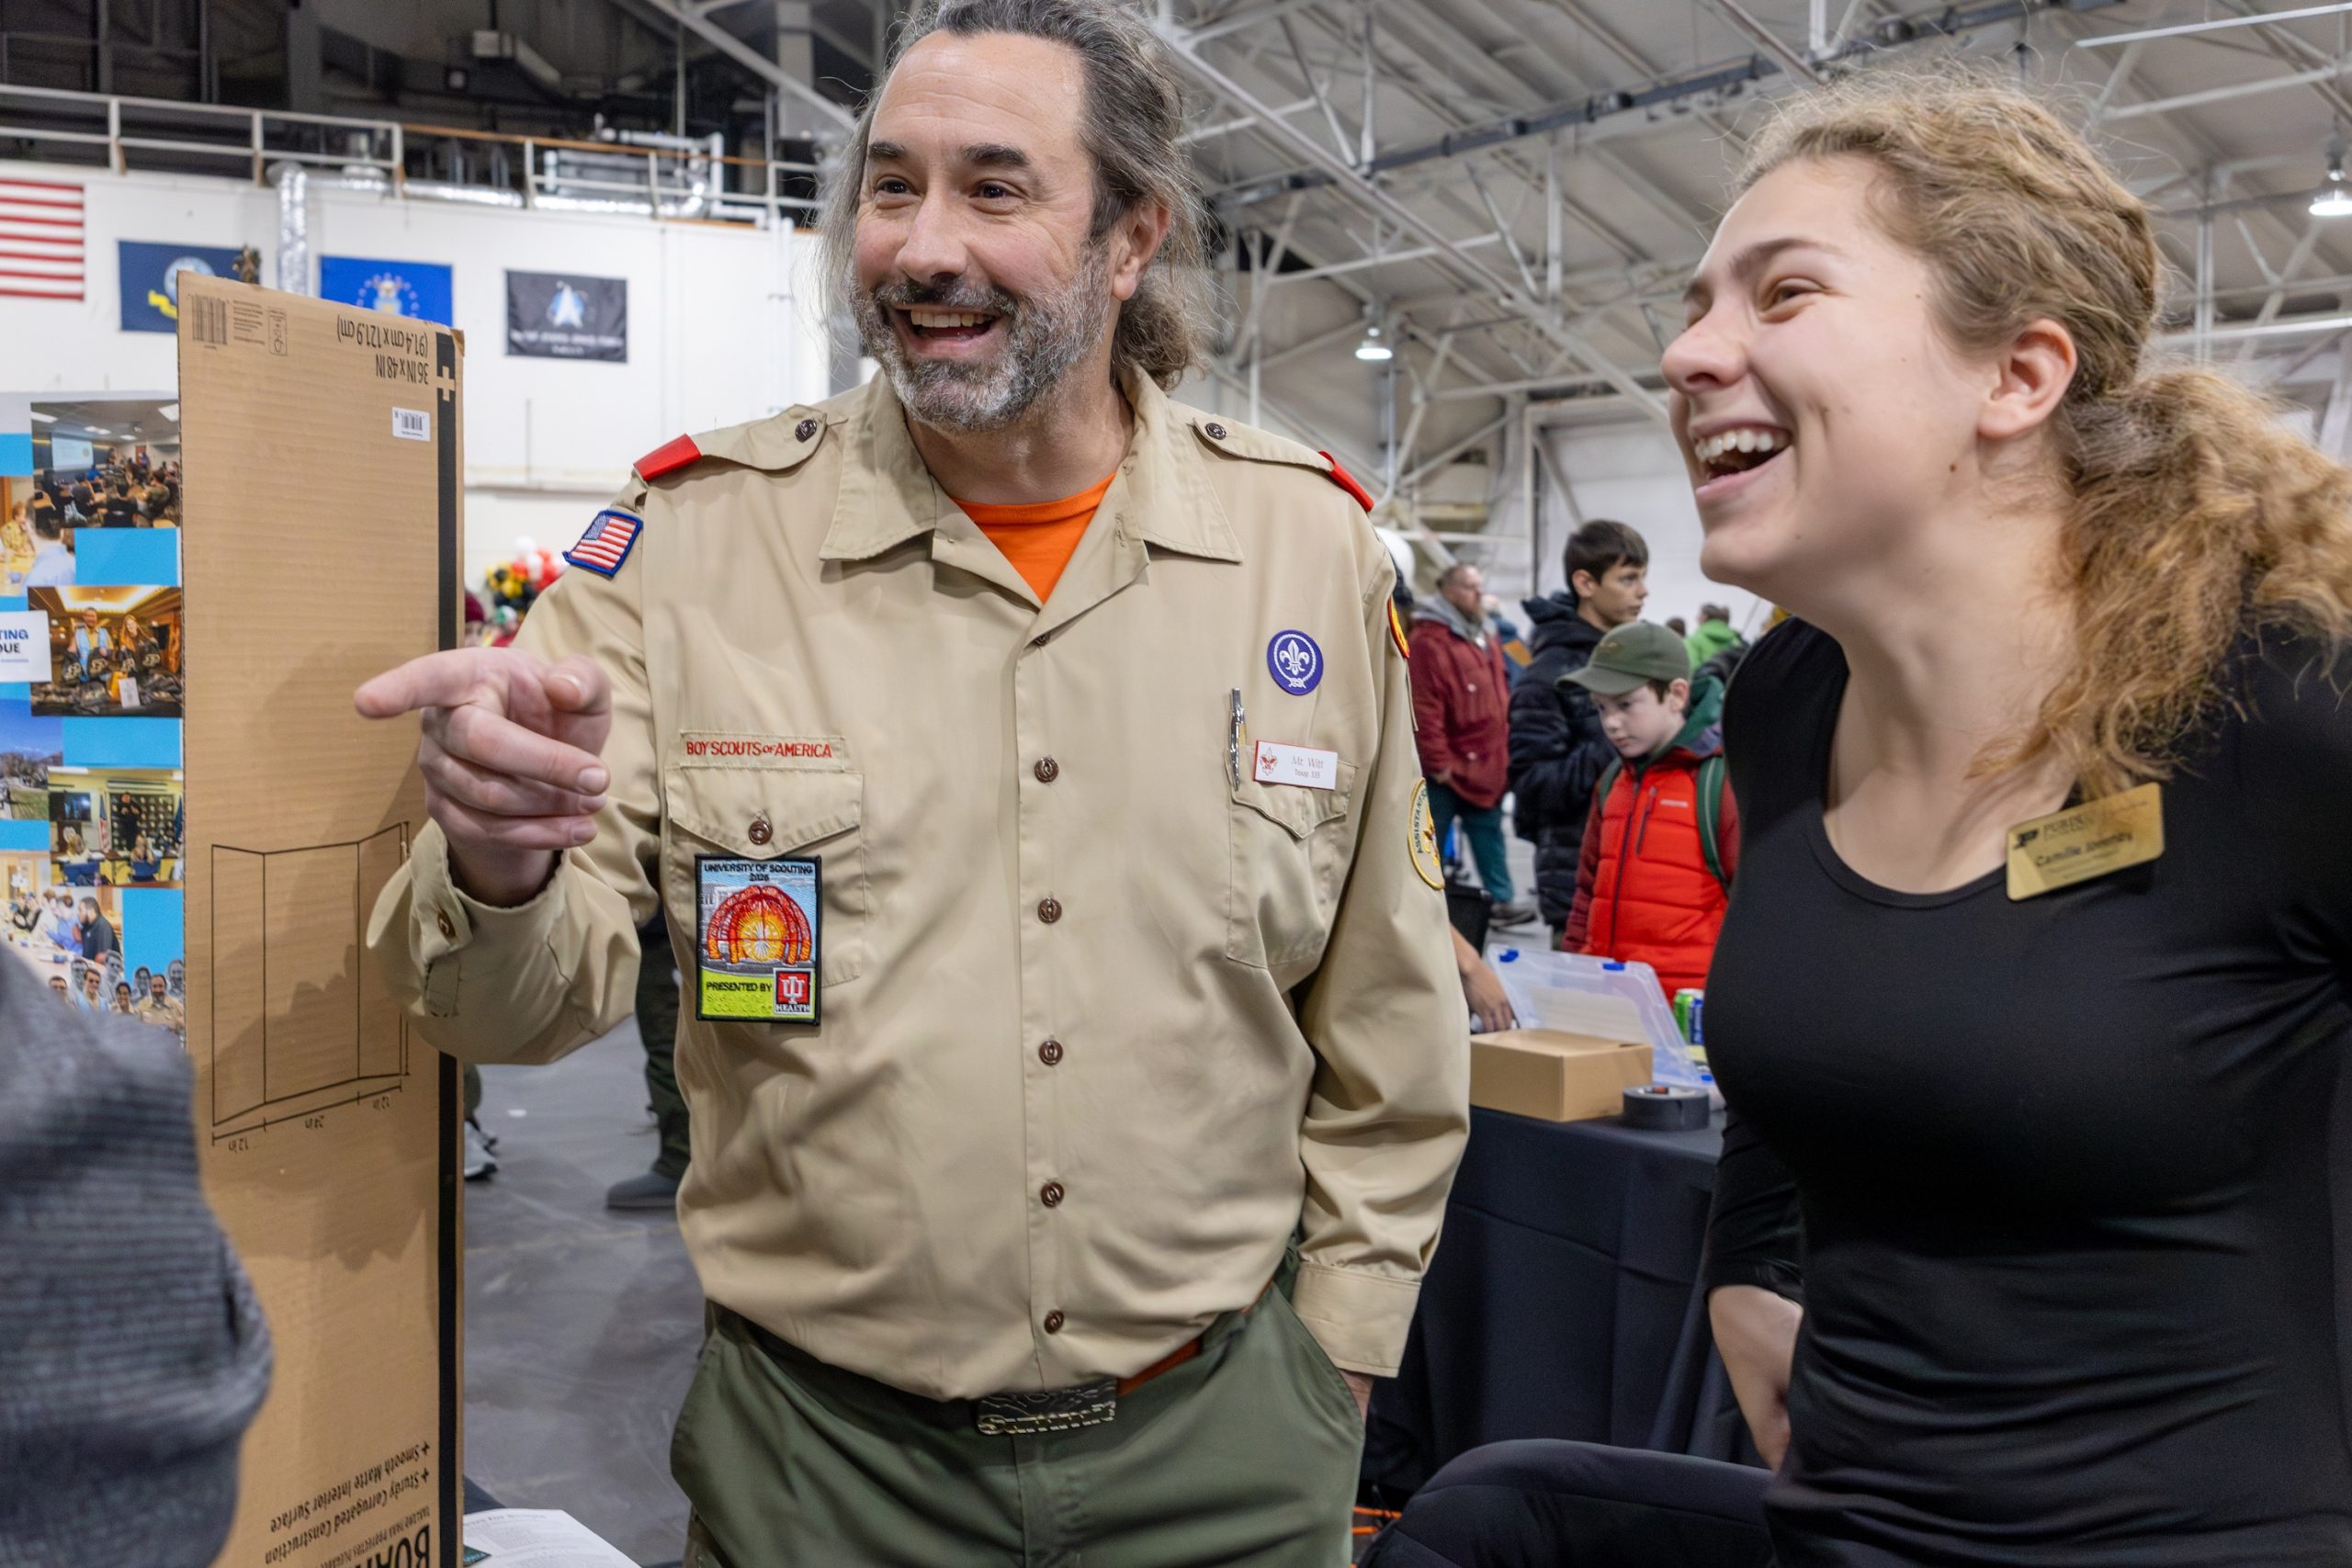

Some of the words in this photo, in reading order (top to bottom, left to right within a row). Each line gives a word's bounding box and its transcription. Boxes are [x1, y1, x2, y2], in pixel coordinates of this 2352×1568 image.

[686, 740, 708, 756] BOY
[711, 741, 763, 756] SCOUTS
[775, 741, 832, 758] AMERICA
[704, 863, 753, 873] UNIVERSITY
[755, 864, 767, 873] OF
[769, 864, 813, 874] SCOUTING
[706, 981, 759, 992] PRESENTED
[760, 982, 773, 993] BY
[775, 1003, 811, 1013] HEALTH
[384, 1444, 420, 1475] Smooth
[354, 1463, 382, 1490] Matte
[390, 1471, 420, 1500] Sturdy
[312, 1480, 352, 1511] Interior
[270, 1500, 311, 1533] Surface
[334, 1489, 388, 1534] Corrugated
[265, 1520, 332, 1565] Construction
